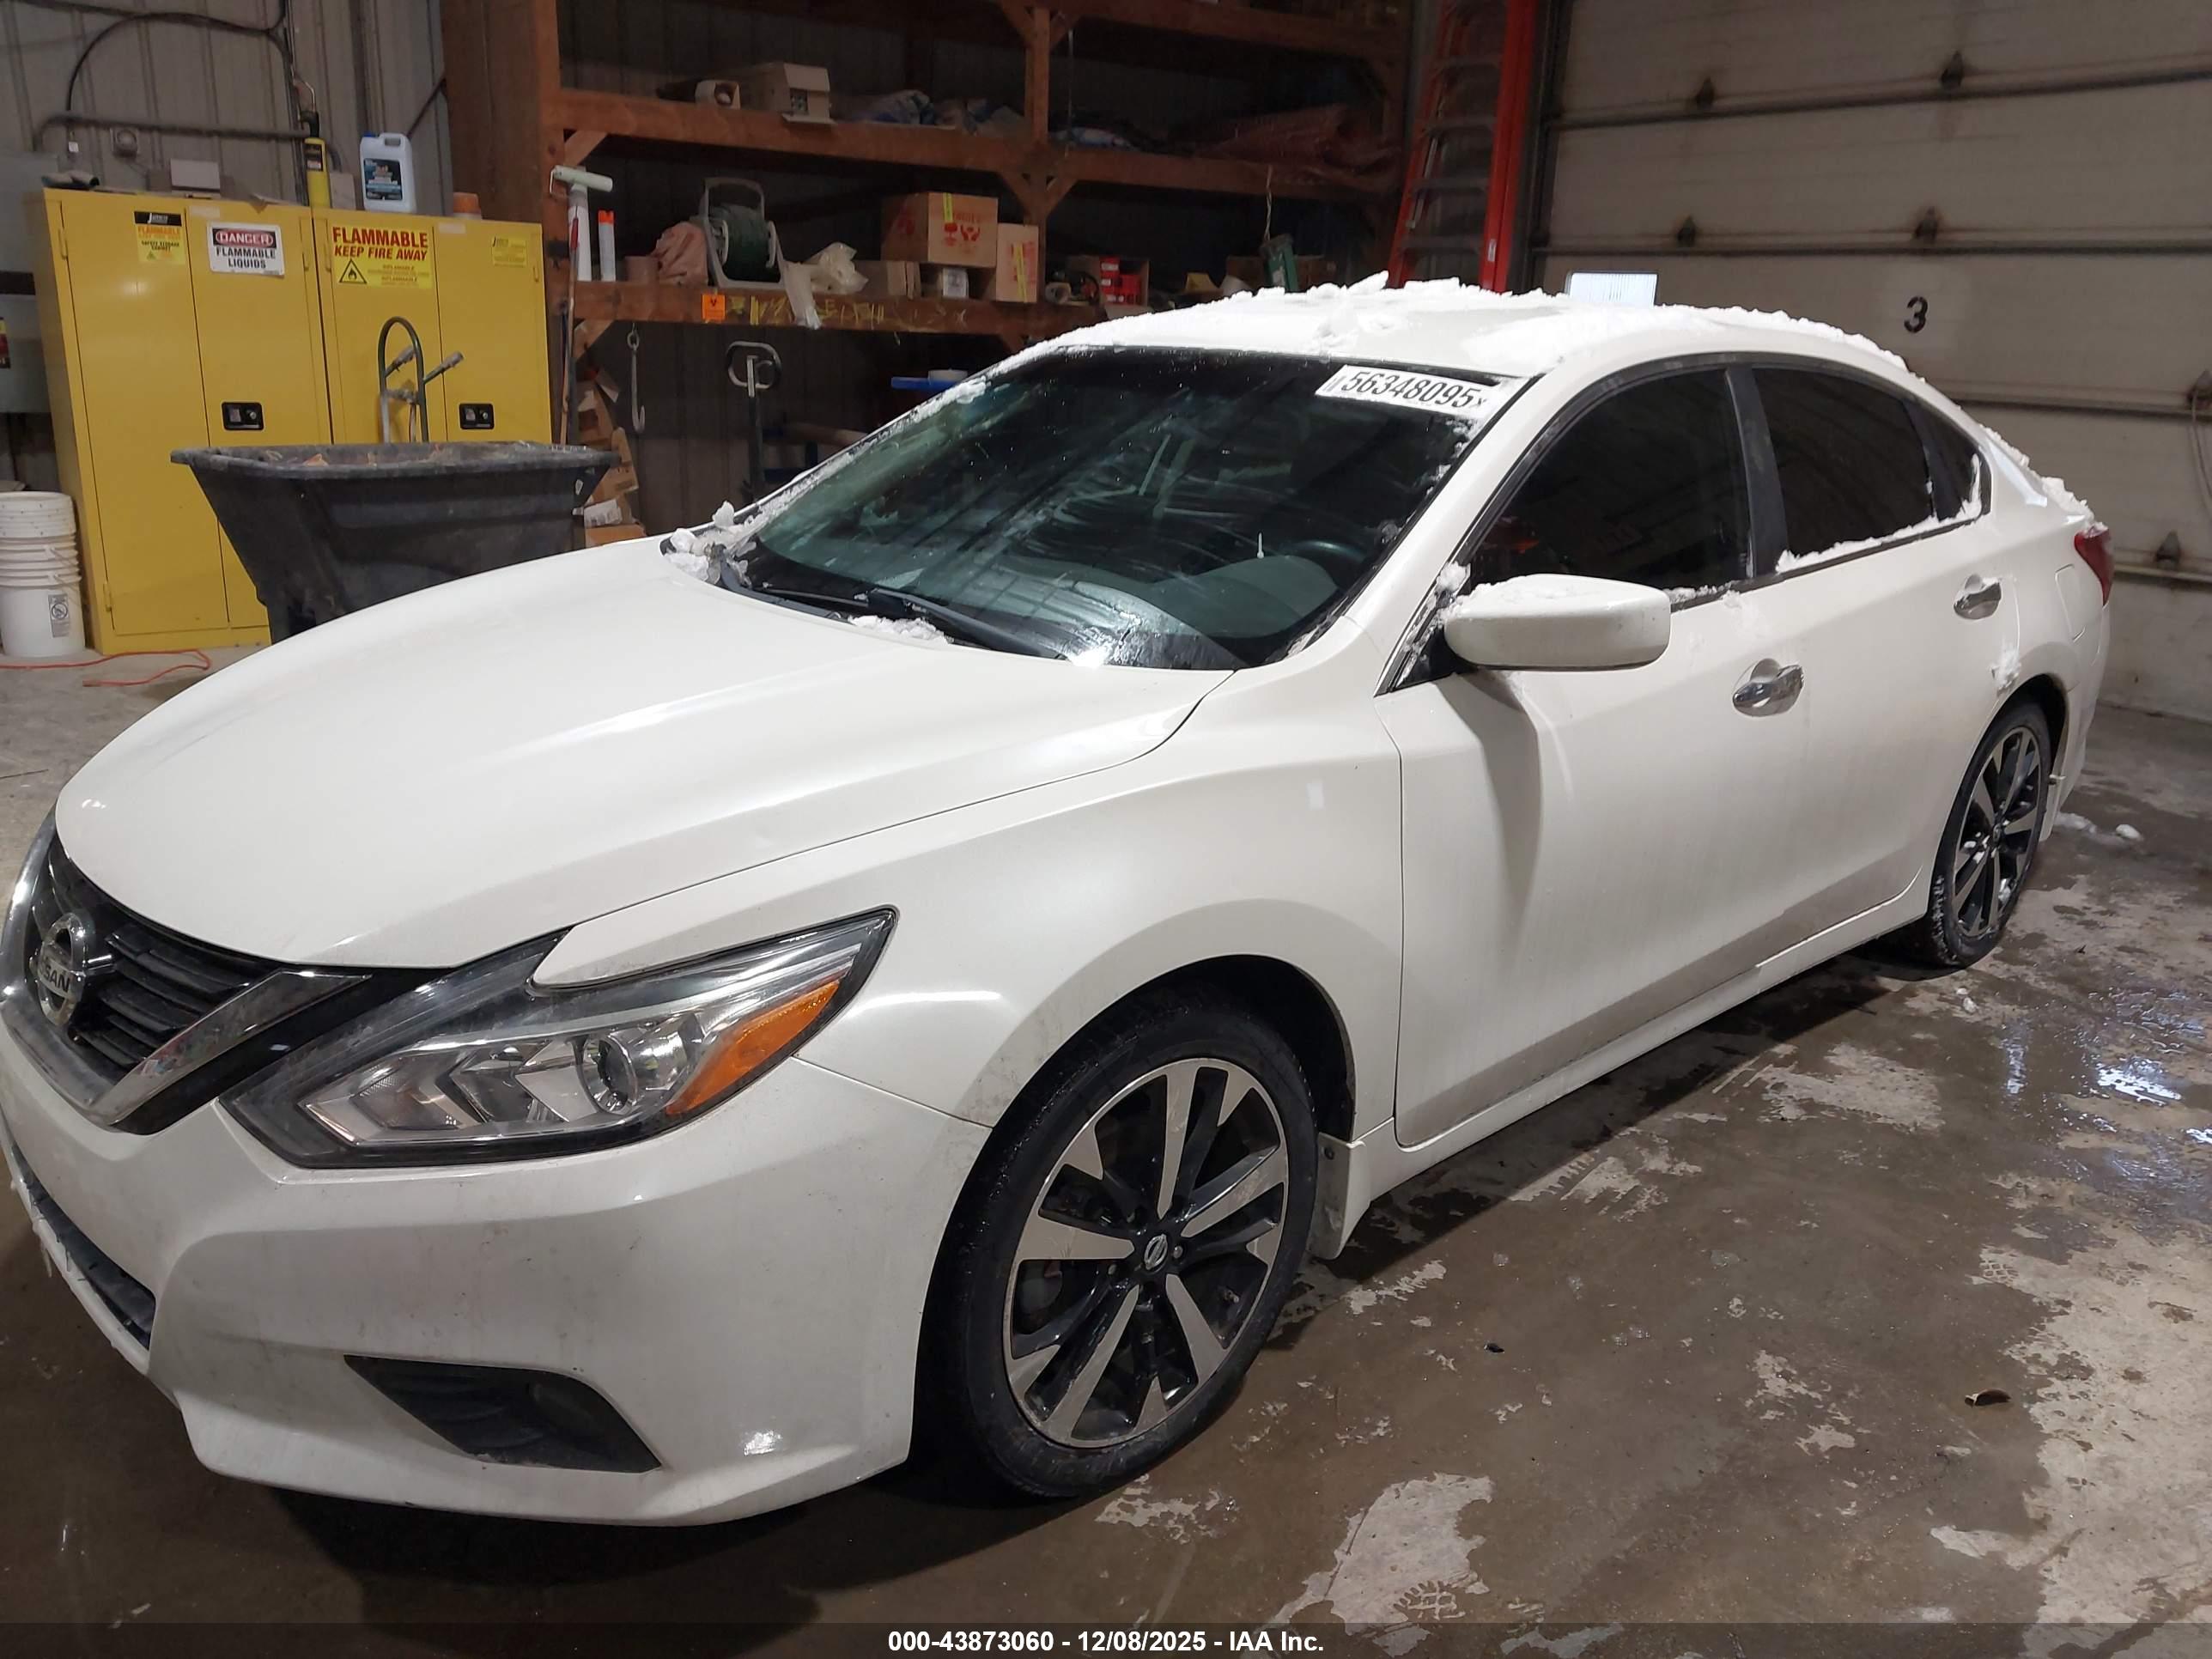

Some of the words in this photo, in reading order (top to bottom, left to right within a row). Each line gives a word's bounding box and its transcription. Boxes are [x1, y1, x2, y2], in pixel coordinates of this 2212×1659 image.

[219, 233, 270, 246] DANGER
[332, 227, 428, 248] FLAMMABLE
[216, 246, 276, 259] FLAMMABLE
[335, 245, 365, 258] KEEP
[368, 247, 392, 259] FIRE
[396, 248, 428, 261] AWAY
[228, 258, 267, 269] LIQUIDS
[1904, 295, 1929, 334] 3
[1340, 371, 1481, 408] 56348095
